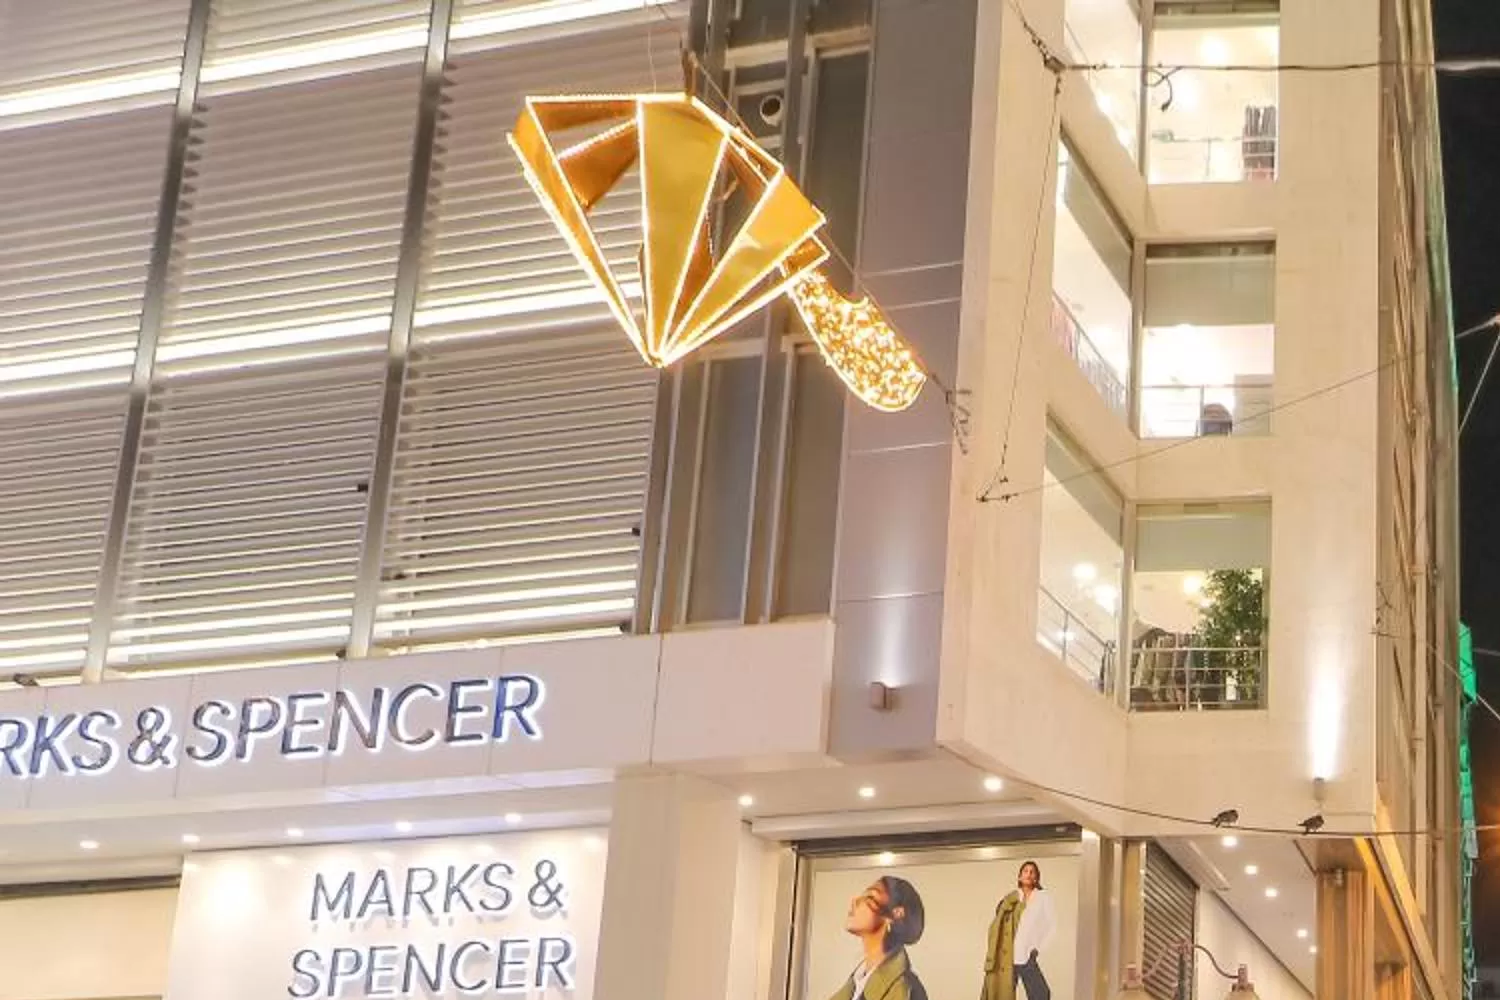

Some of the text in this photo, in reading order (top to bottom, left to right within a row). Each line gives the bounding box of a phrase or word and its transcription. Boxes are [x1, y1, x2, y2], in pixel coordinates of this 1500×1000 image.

[127, 706, 174, 766] &
[185, 673, 542, 762] SPENCER
[310, 859, 565, 921] MARKS &
[286, 936, 574, 999] SPENCER
